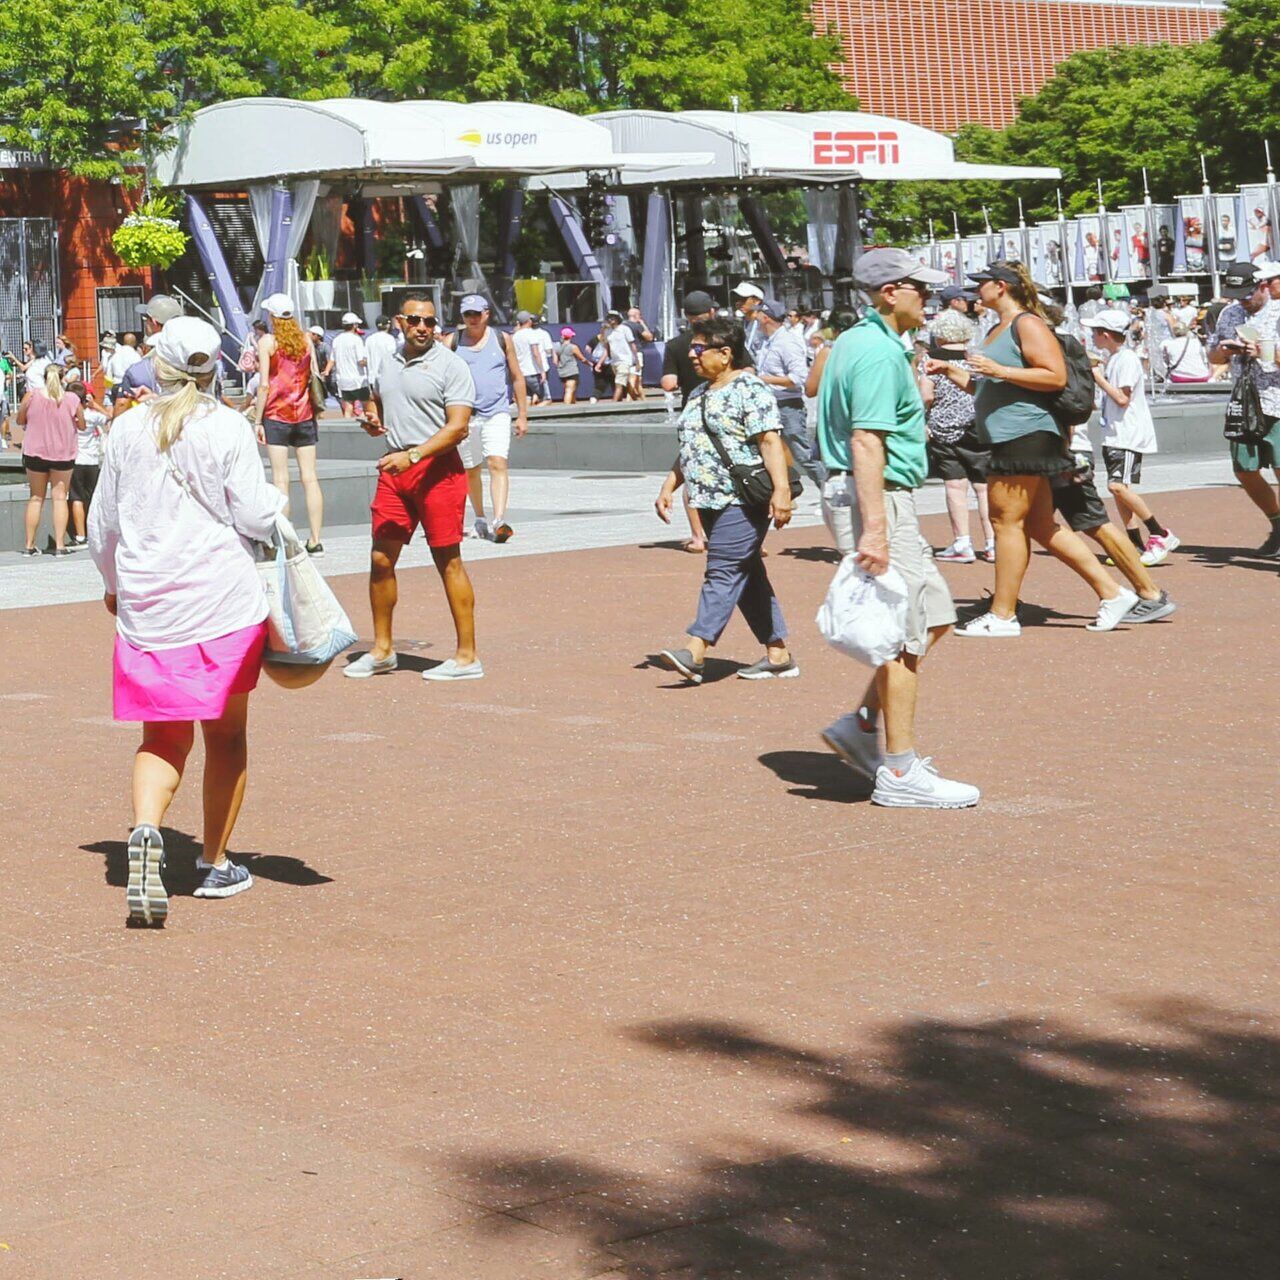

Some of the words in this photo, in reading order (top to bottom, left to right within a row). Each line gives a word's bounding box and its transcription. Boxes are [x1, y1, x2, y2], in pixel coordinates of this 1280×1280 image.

[486, 133, 502, 144] us
[504, 133, 537, 149] open
[813, 131, 899, 164] ESPN
[0, 150, 40, 162] ENTRY
